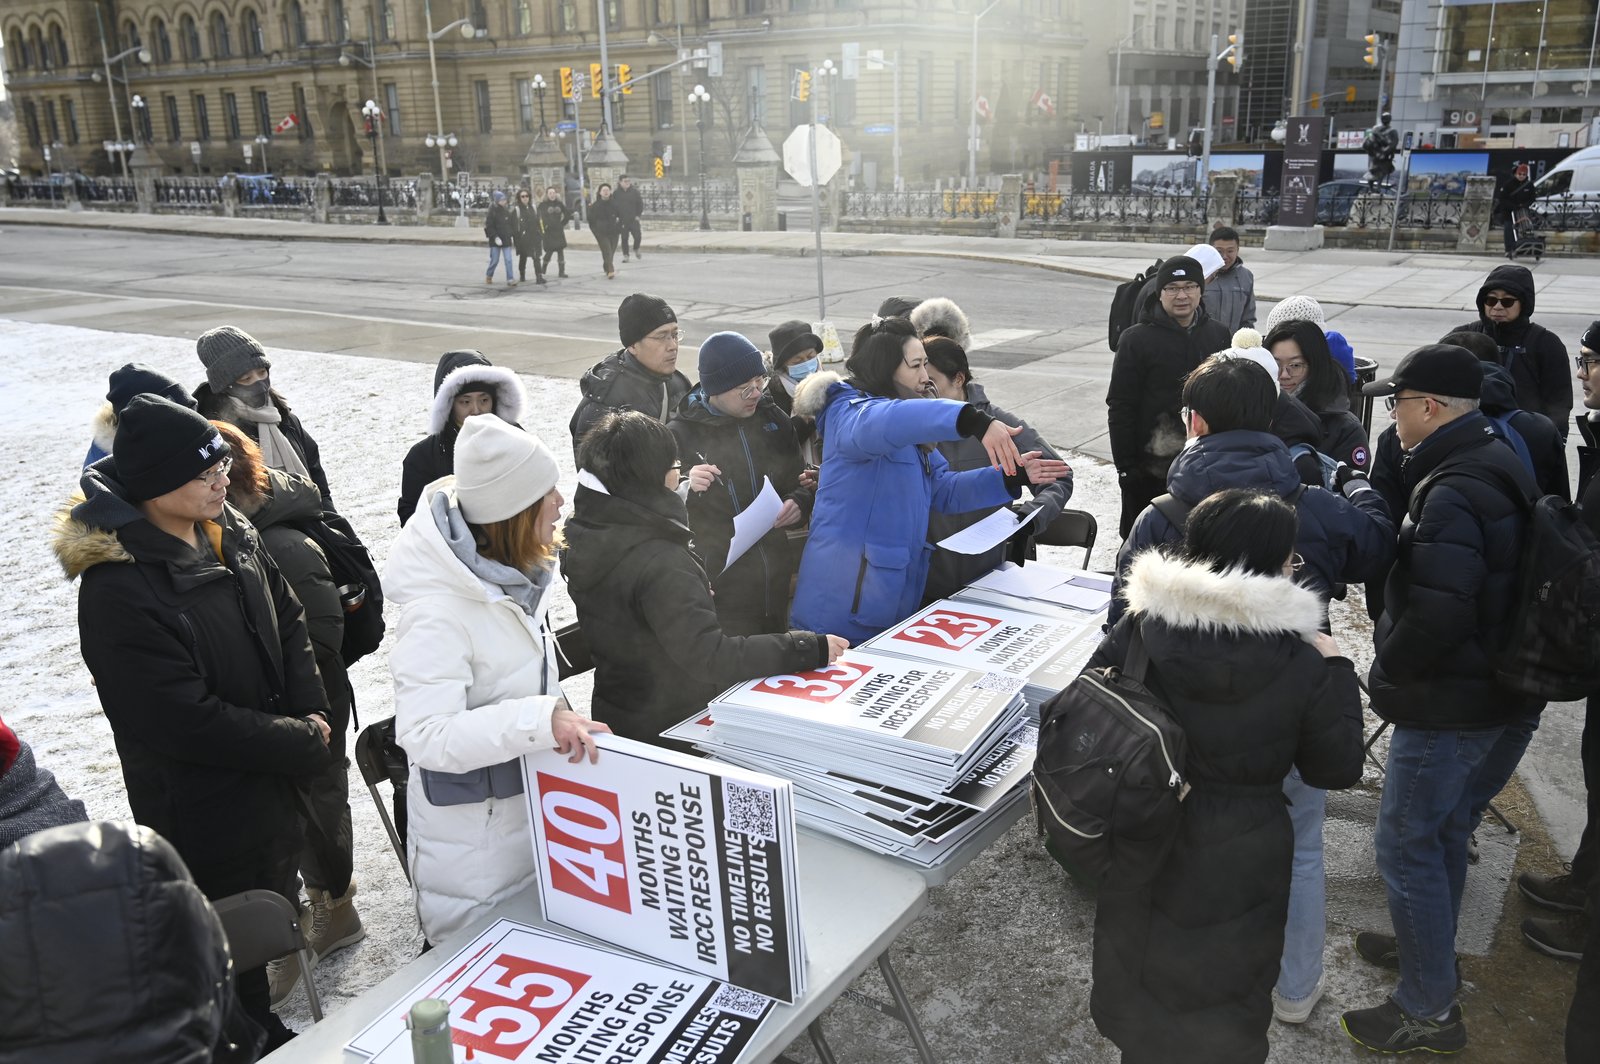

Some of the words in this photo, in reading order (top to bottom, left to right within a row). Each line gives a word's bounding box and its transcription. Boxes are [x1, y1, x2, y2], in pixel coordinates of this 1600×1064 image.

[903, 613, 992, 647] 23
[975, 625, 1022, 653] MONTHS
[986, 637, 1030, 665] WAITING
[1024, 623, 1051, 639] FOR
[1003, 655, 1034, 675] IRCC
[1023, 624, 1076, 659] RESPONSE
[846, 673, 895, 707] MONTHS
[860, 685, 910, 719] WAITING
[898, 669, 928, 686] FOR
[879, 709, 913, 731] IRCC
[900, 669, 956, 712] RESPONSE
[949, 720, 971, 732] NO
[960, 690, 998, 721] RESULTS
[924, 717, 947, 730] NO
[978, 774, 1001, 788] NO
[655, 791, 678, 839] FOR
[542, 791, 625, 897] 40
[631, 811, 661, 911] MONTHS
[680, 782, 712, 912] RESPONSE
[661, 844, 689, 940] WAITING
[747, 833, 773, 921] RESULTS
[693, 912, 717, 965] IRCC
[732, 925, 752, 954] NO
[755, 923, 775, 953] NO
[448, 963, 574, 1045] 55
[535, 991, 614, 1064] MONTHS
[567, 1017, 629, 1064] ITING
[615, 982, 659, 1015] FOR
